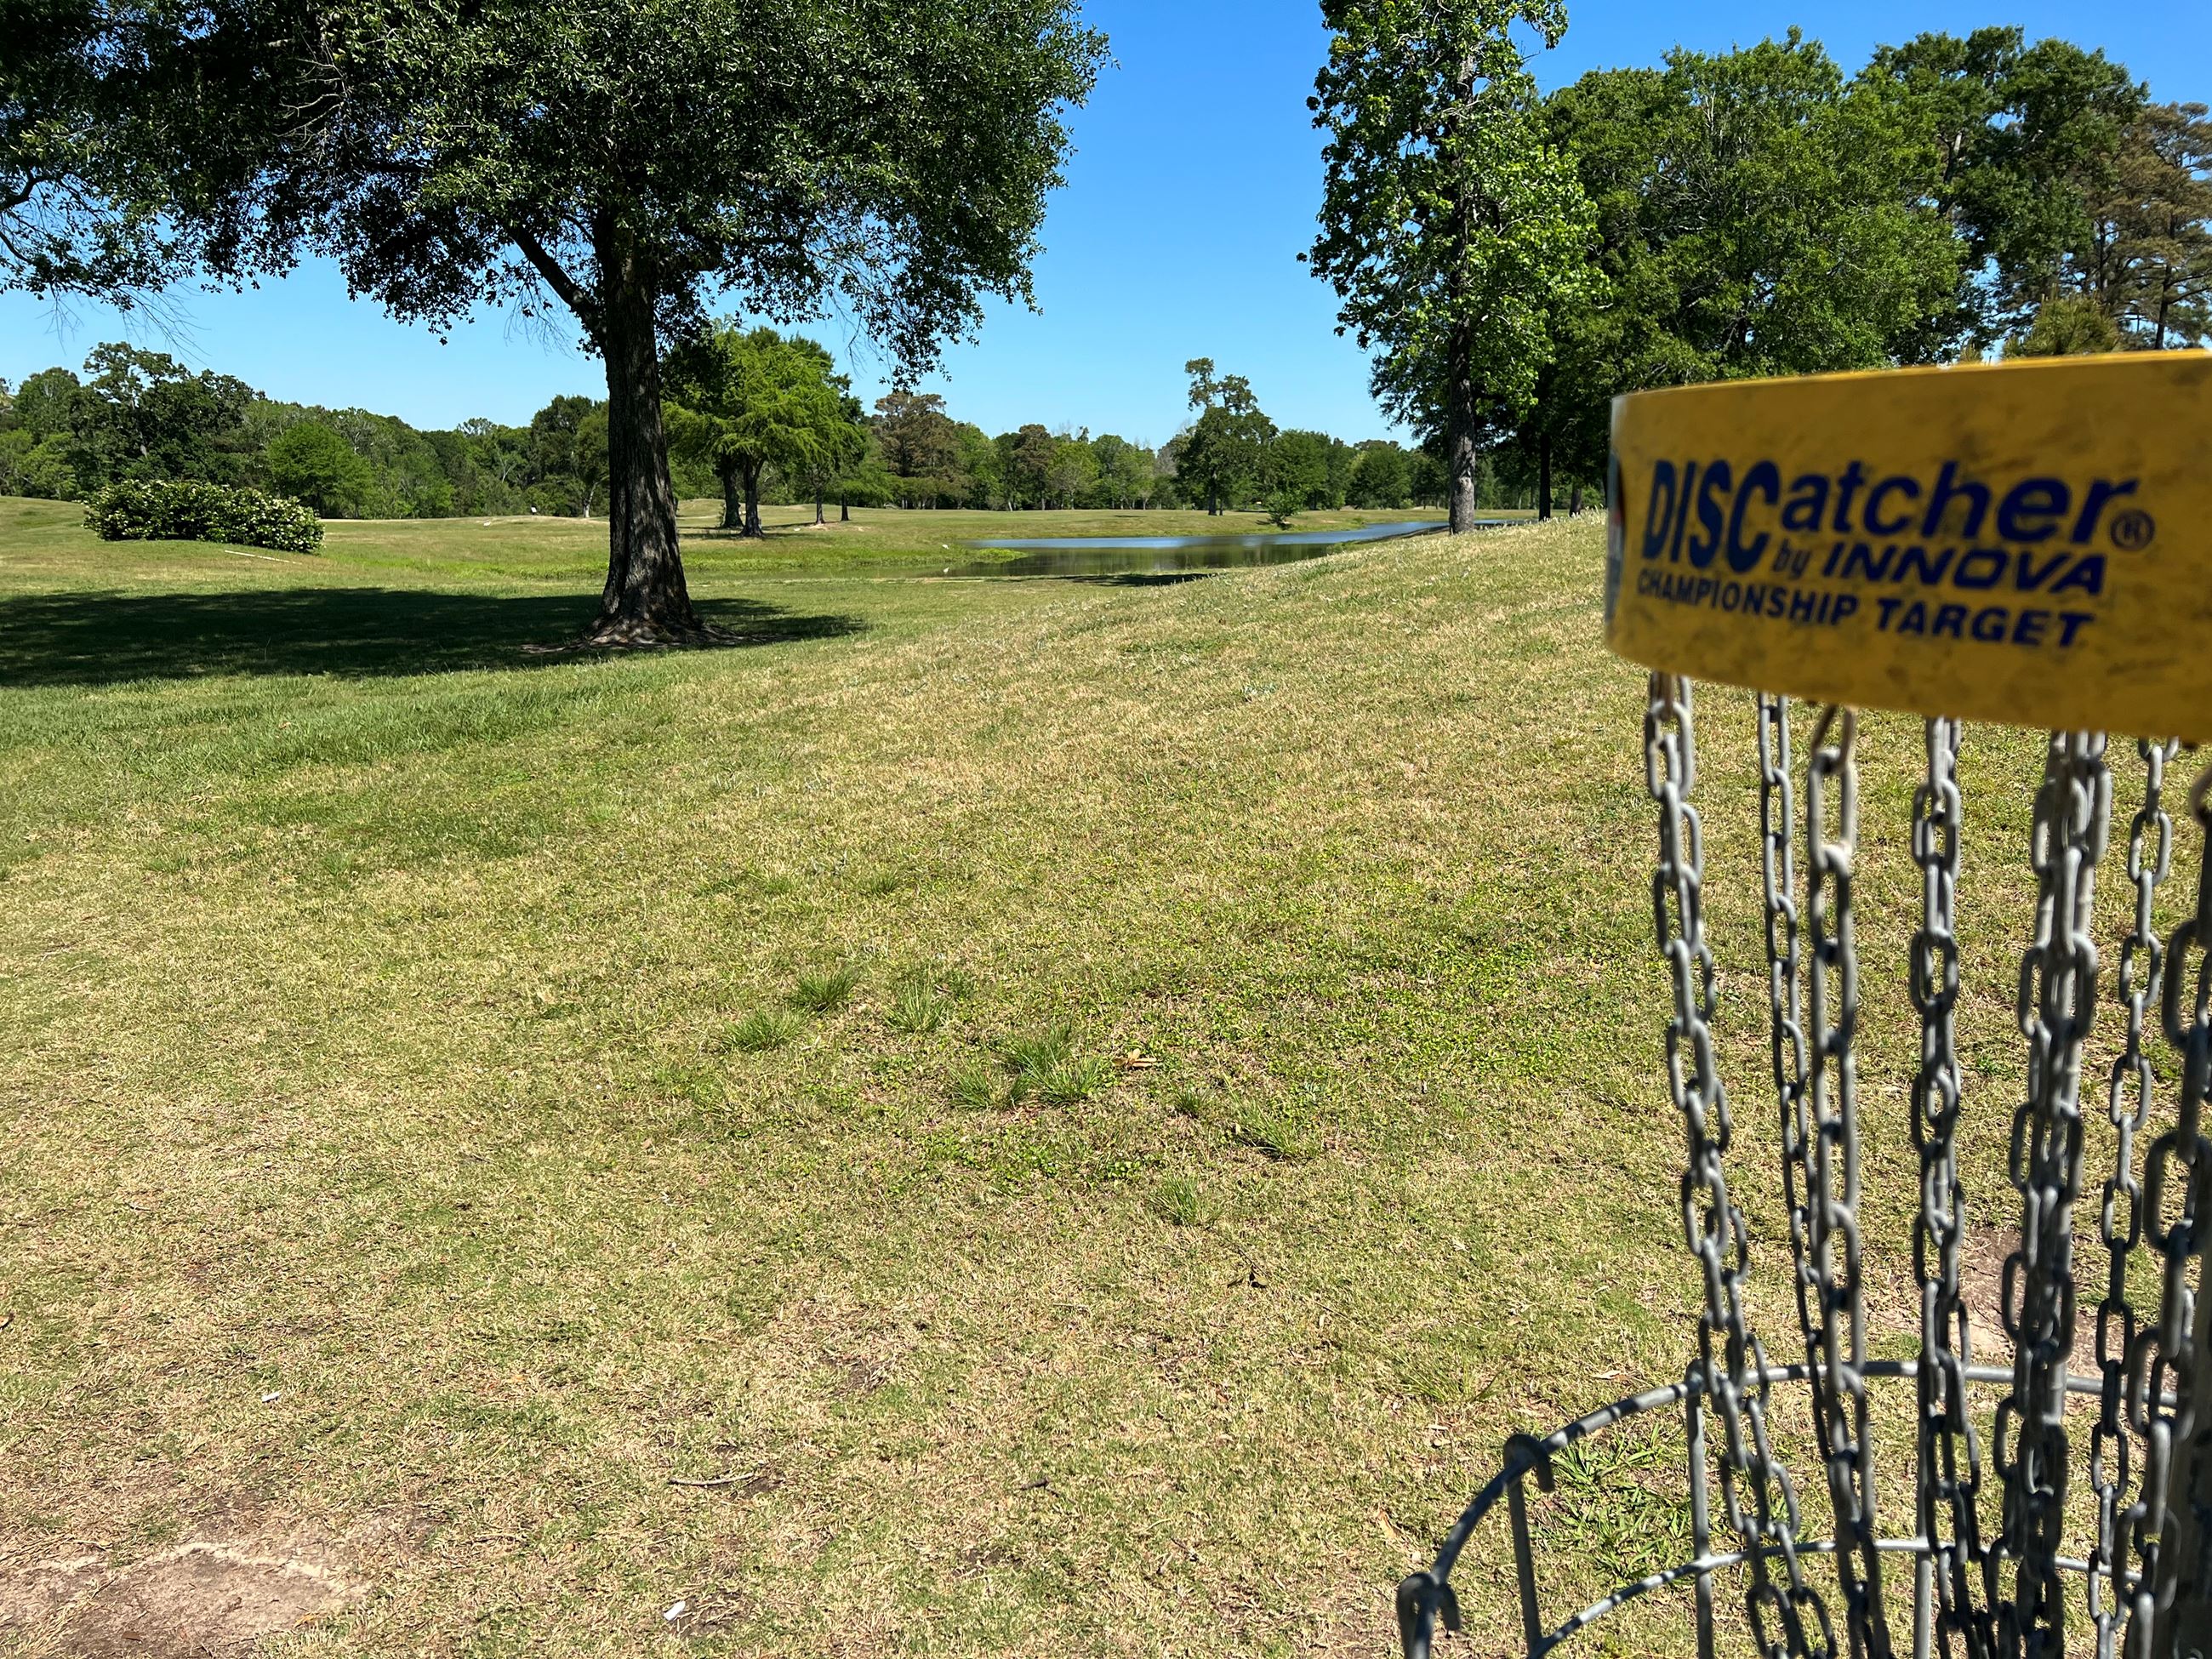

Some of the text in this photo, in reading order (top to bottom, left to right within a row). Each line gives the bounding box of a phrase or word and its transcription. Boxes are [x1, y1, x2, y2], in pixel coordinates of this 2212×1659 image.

[1772, 539, 2107, 595] by INNOVA
[1636, 567, 2095, 647] CHAMPIONSHIP TARGET
